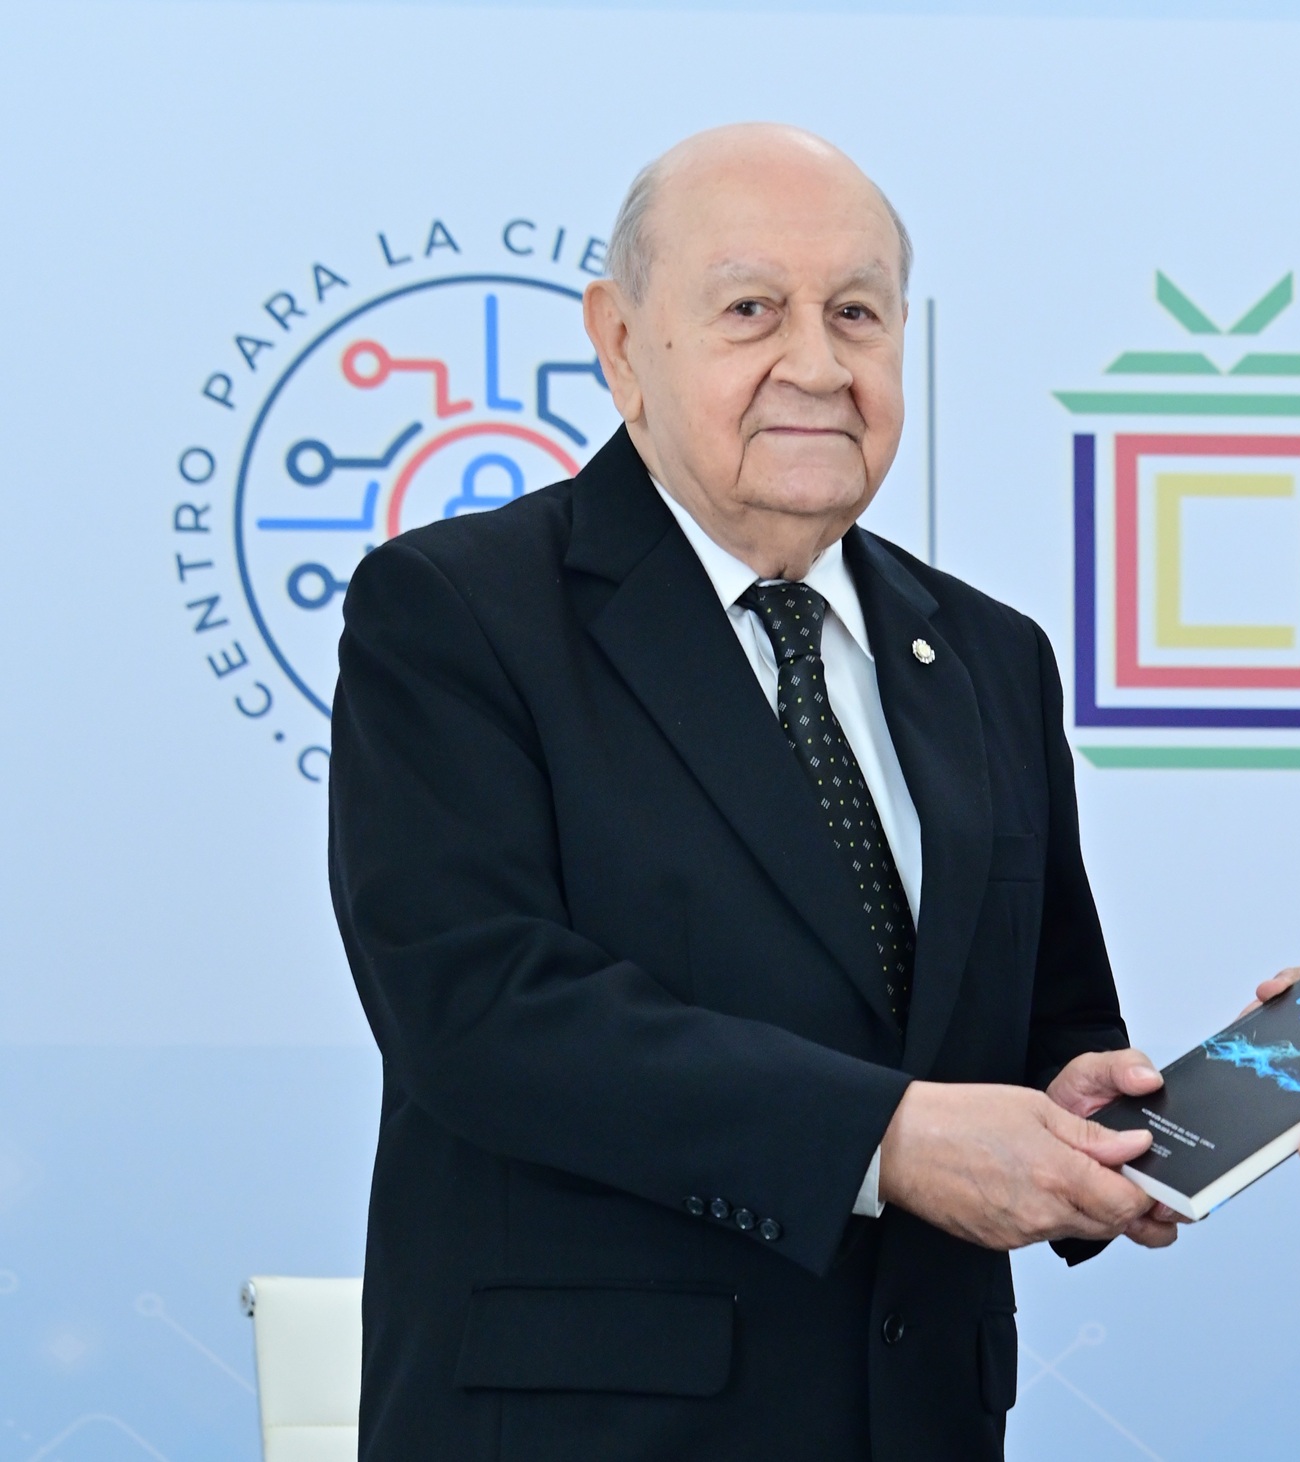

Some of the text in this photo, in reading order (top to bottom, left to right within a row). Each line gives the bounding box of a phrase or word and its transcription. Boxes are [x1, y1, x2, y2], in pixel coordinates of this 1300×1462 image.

[174, 219, 461, 718] CENTRO PARA LA
